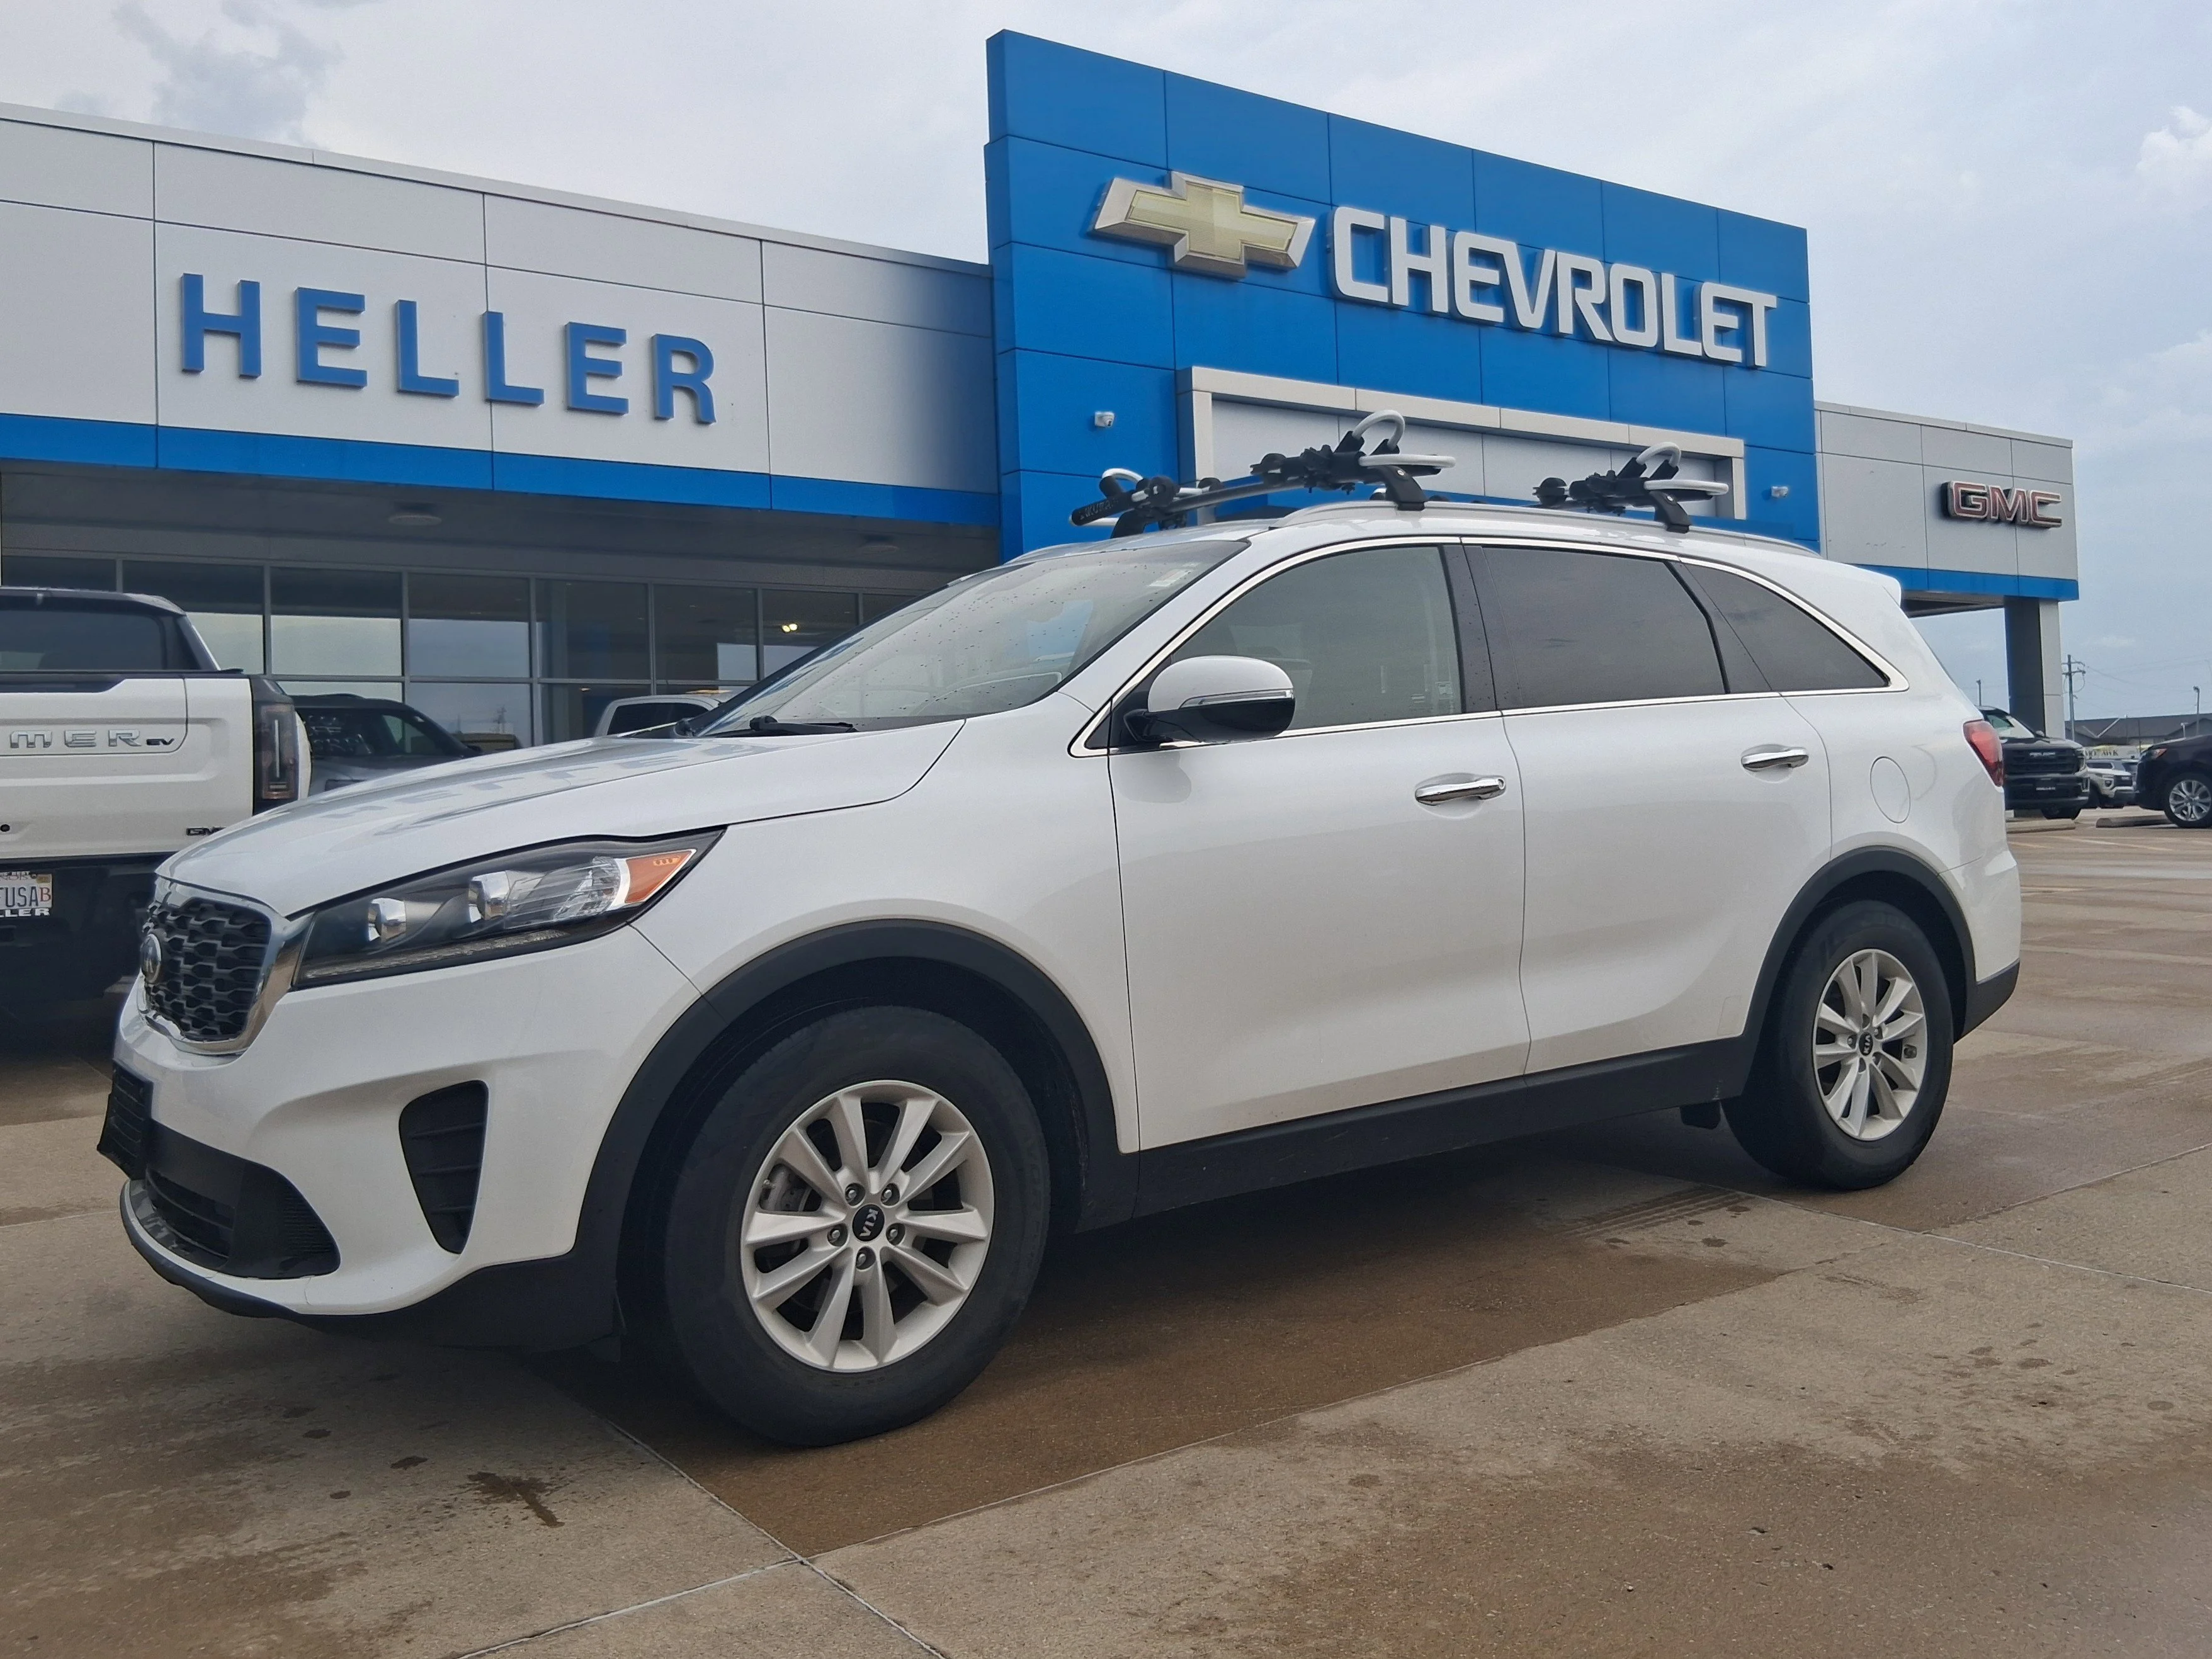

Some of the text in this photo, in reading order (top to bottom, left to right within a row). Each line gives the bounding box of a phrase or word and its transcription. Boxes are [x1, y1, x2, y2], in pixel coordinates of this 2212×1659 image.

[1330, 206, 1778, 368] CHEVROLET
[180, 273, 717, 425] HELLER
[1947, 480, 2062, 528] GMC
[146, 738, 174, 746] EV
[859, 1208, 879, 1237] KIA
